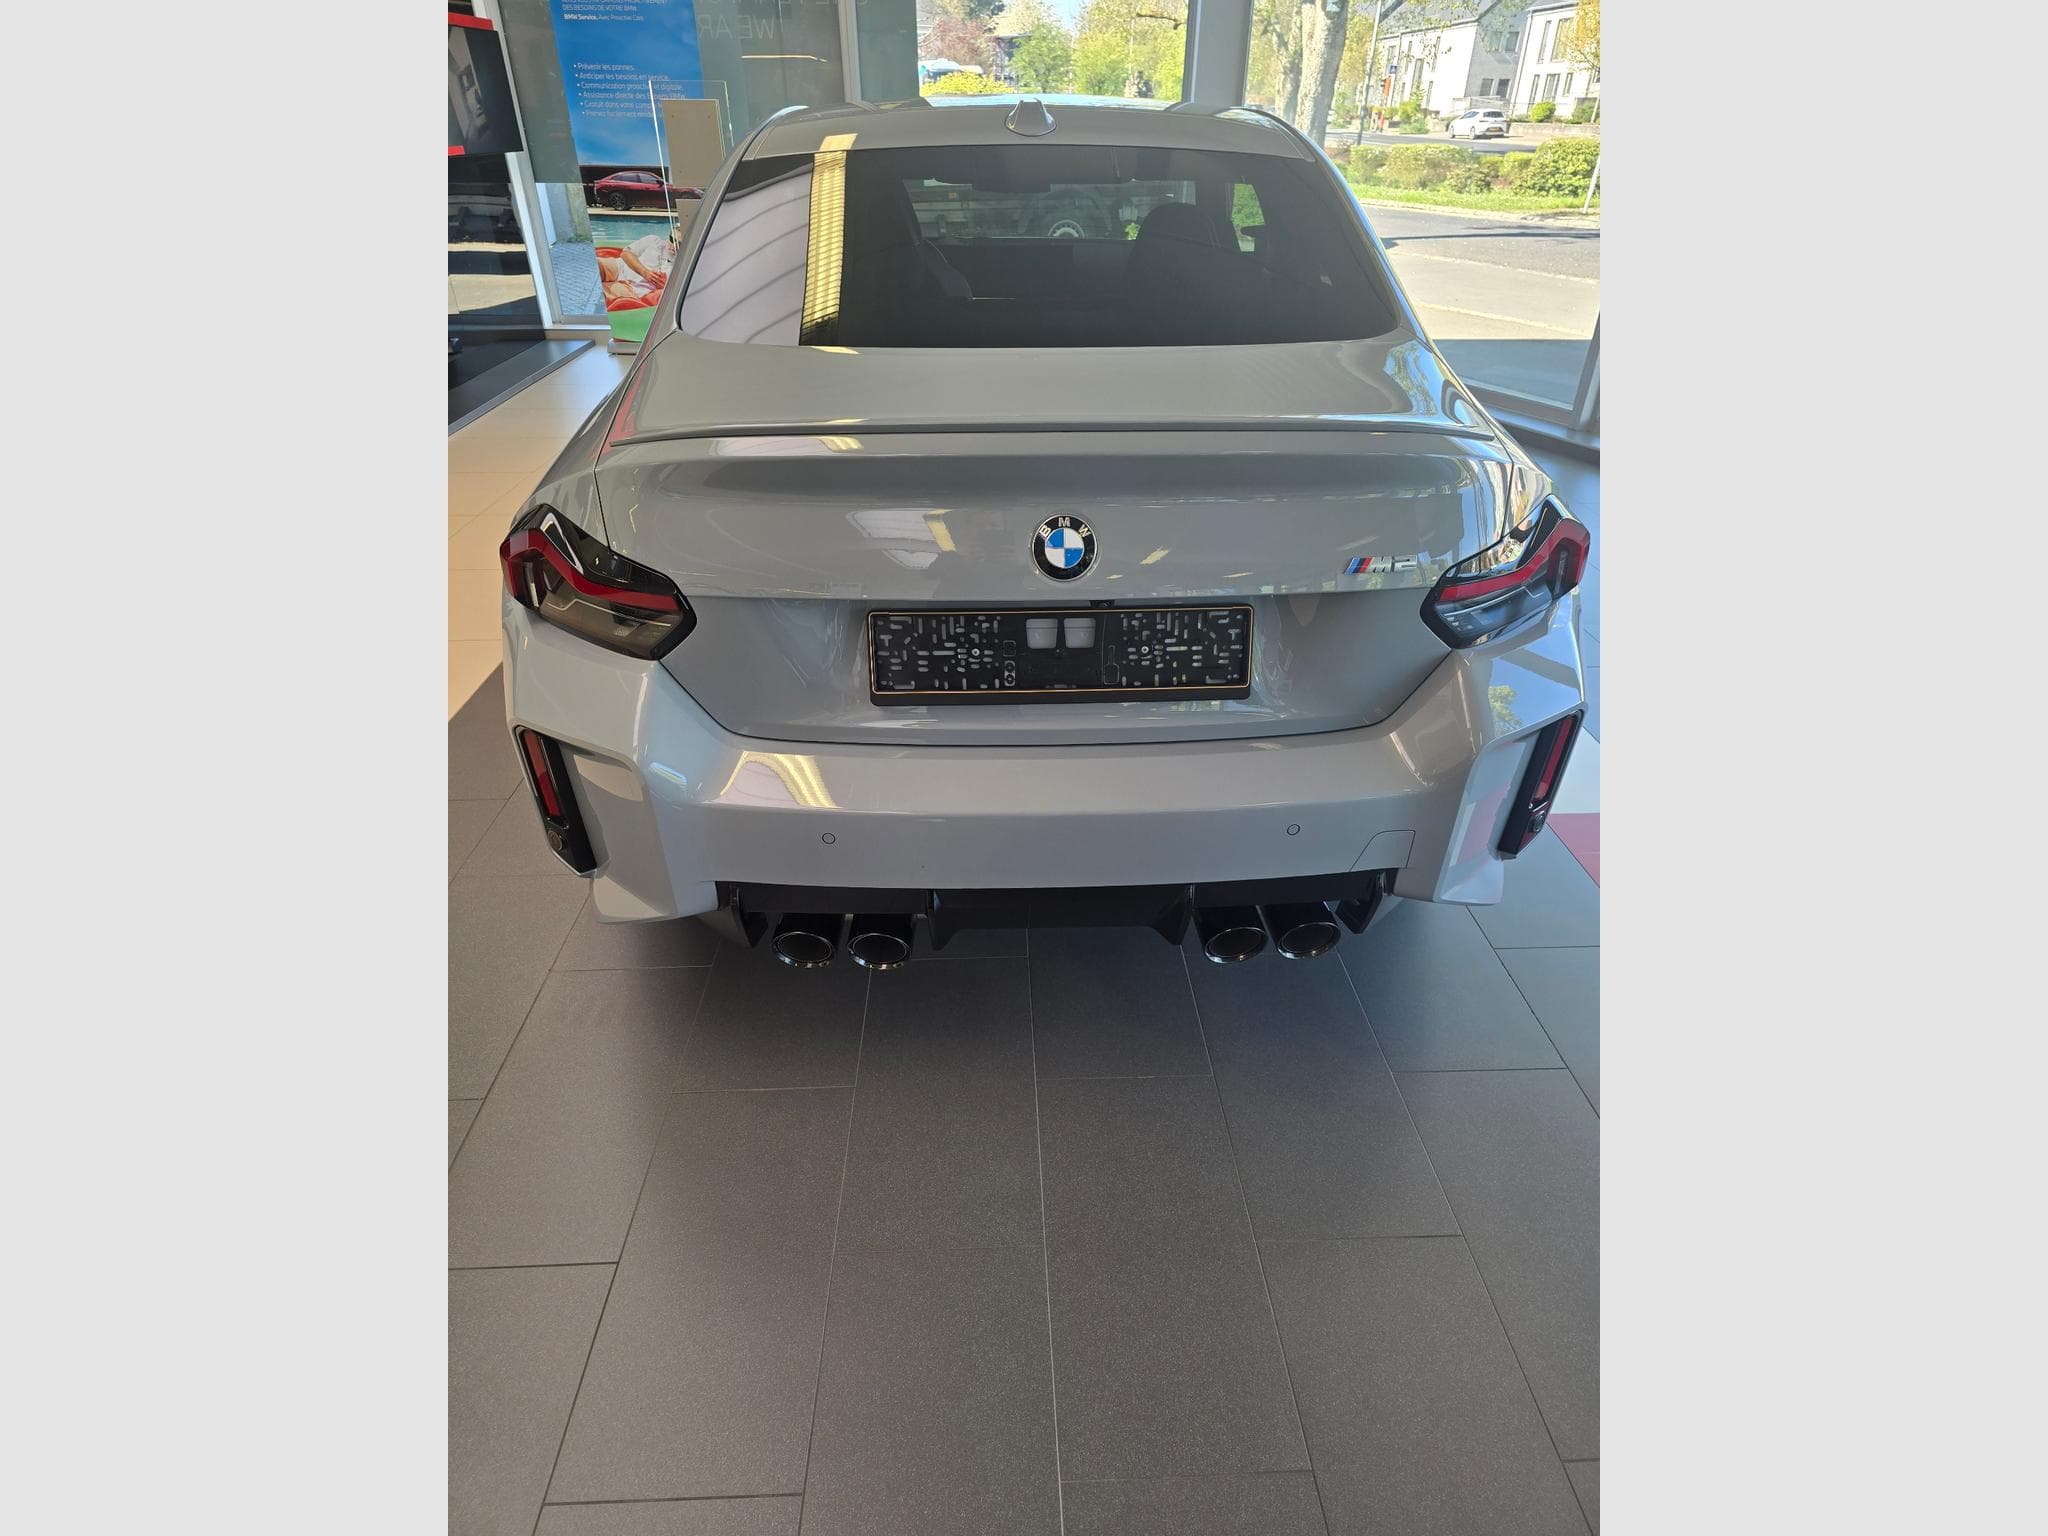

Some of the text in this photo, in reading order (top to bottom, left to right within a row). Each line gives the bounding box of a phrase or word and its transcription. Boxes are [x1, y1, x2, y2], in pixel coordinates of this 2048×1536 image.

[580, 81, 625, 89] Communication
[1039, 517, 1091, 538] BMW
[1364, 554, 1417, 573] M2
